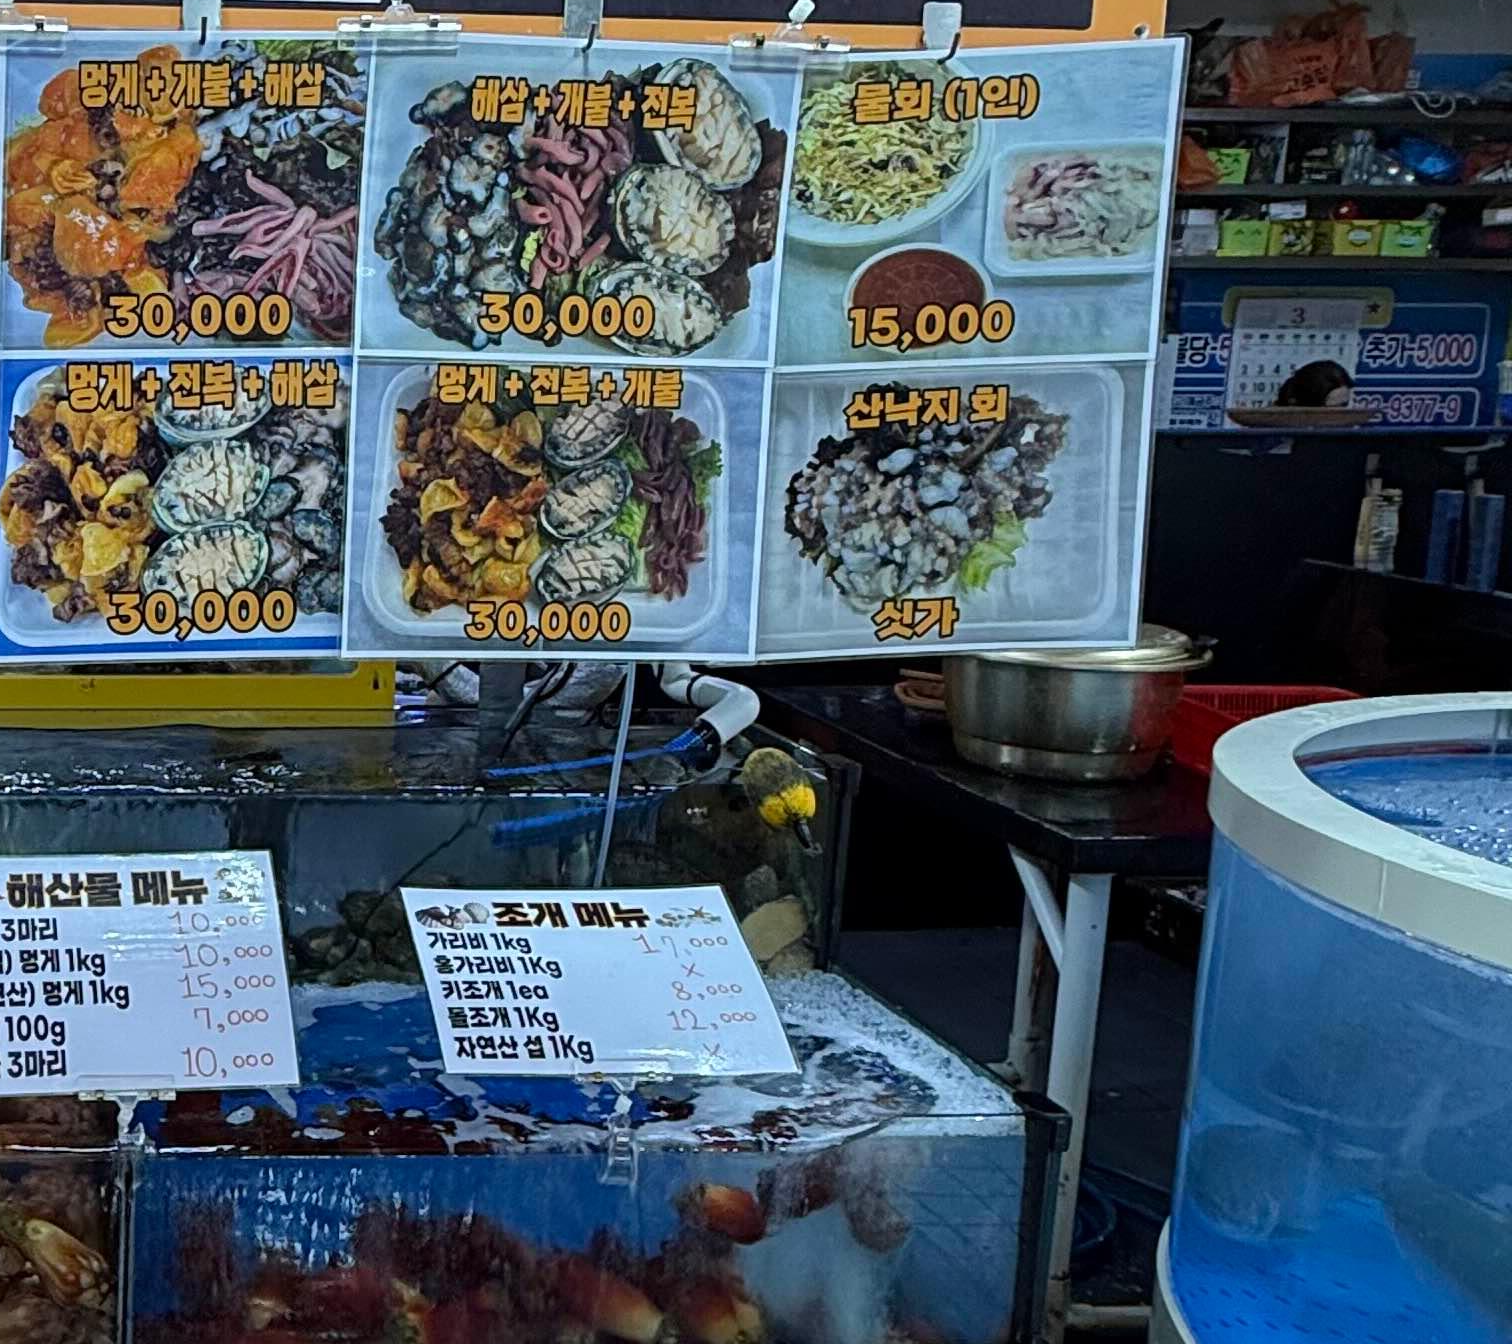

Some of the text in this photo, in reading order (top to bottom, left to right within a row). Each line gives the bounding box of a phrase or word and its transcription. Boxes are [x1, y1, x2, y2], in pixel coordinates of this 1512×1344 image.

[851, 74, 1040, 124] 물회 (1인)
[104, 293, 292, 345] 30,000
[479, 292, 655, 341] 30,000
[848, 300, 1015, 352] 15,000
[844, 384, 1010, 430] 산낙지 회
[106, 589, 296, 640] 30,000
[464, 601, 631, 646] 30,000
[872, 597, 958, 641] 싯가
[5, 869, 209, 909] 해산물 메뉴
[1, 917, 59, 943] 3마리
[492, 901, 652, 929] 조개 메뉴
[426, 931, 488, 952] 가리비
[18, 950, 60, 974] 멍게
[68, 948, 106, 978] 1kg
[42, 981, 84, 1007] 멍게
[88, 980, 130, 1010] 1kg
[440, 980, 505, 1001] 키조개
[508, 980, 550, 1001] 1ea
[4, 1015, 66, 1046] 100g
[454, 1035, 520, 1060] 자연산
[7, 1050, 67, 1078] 3마리
